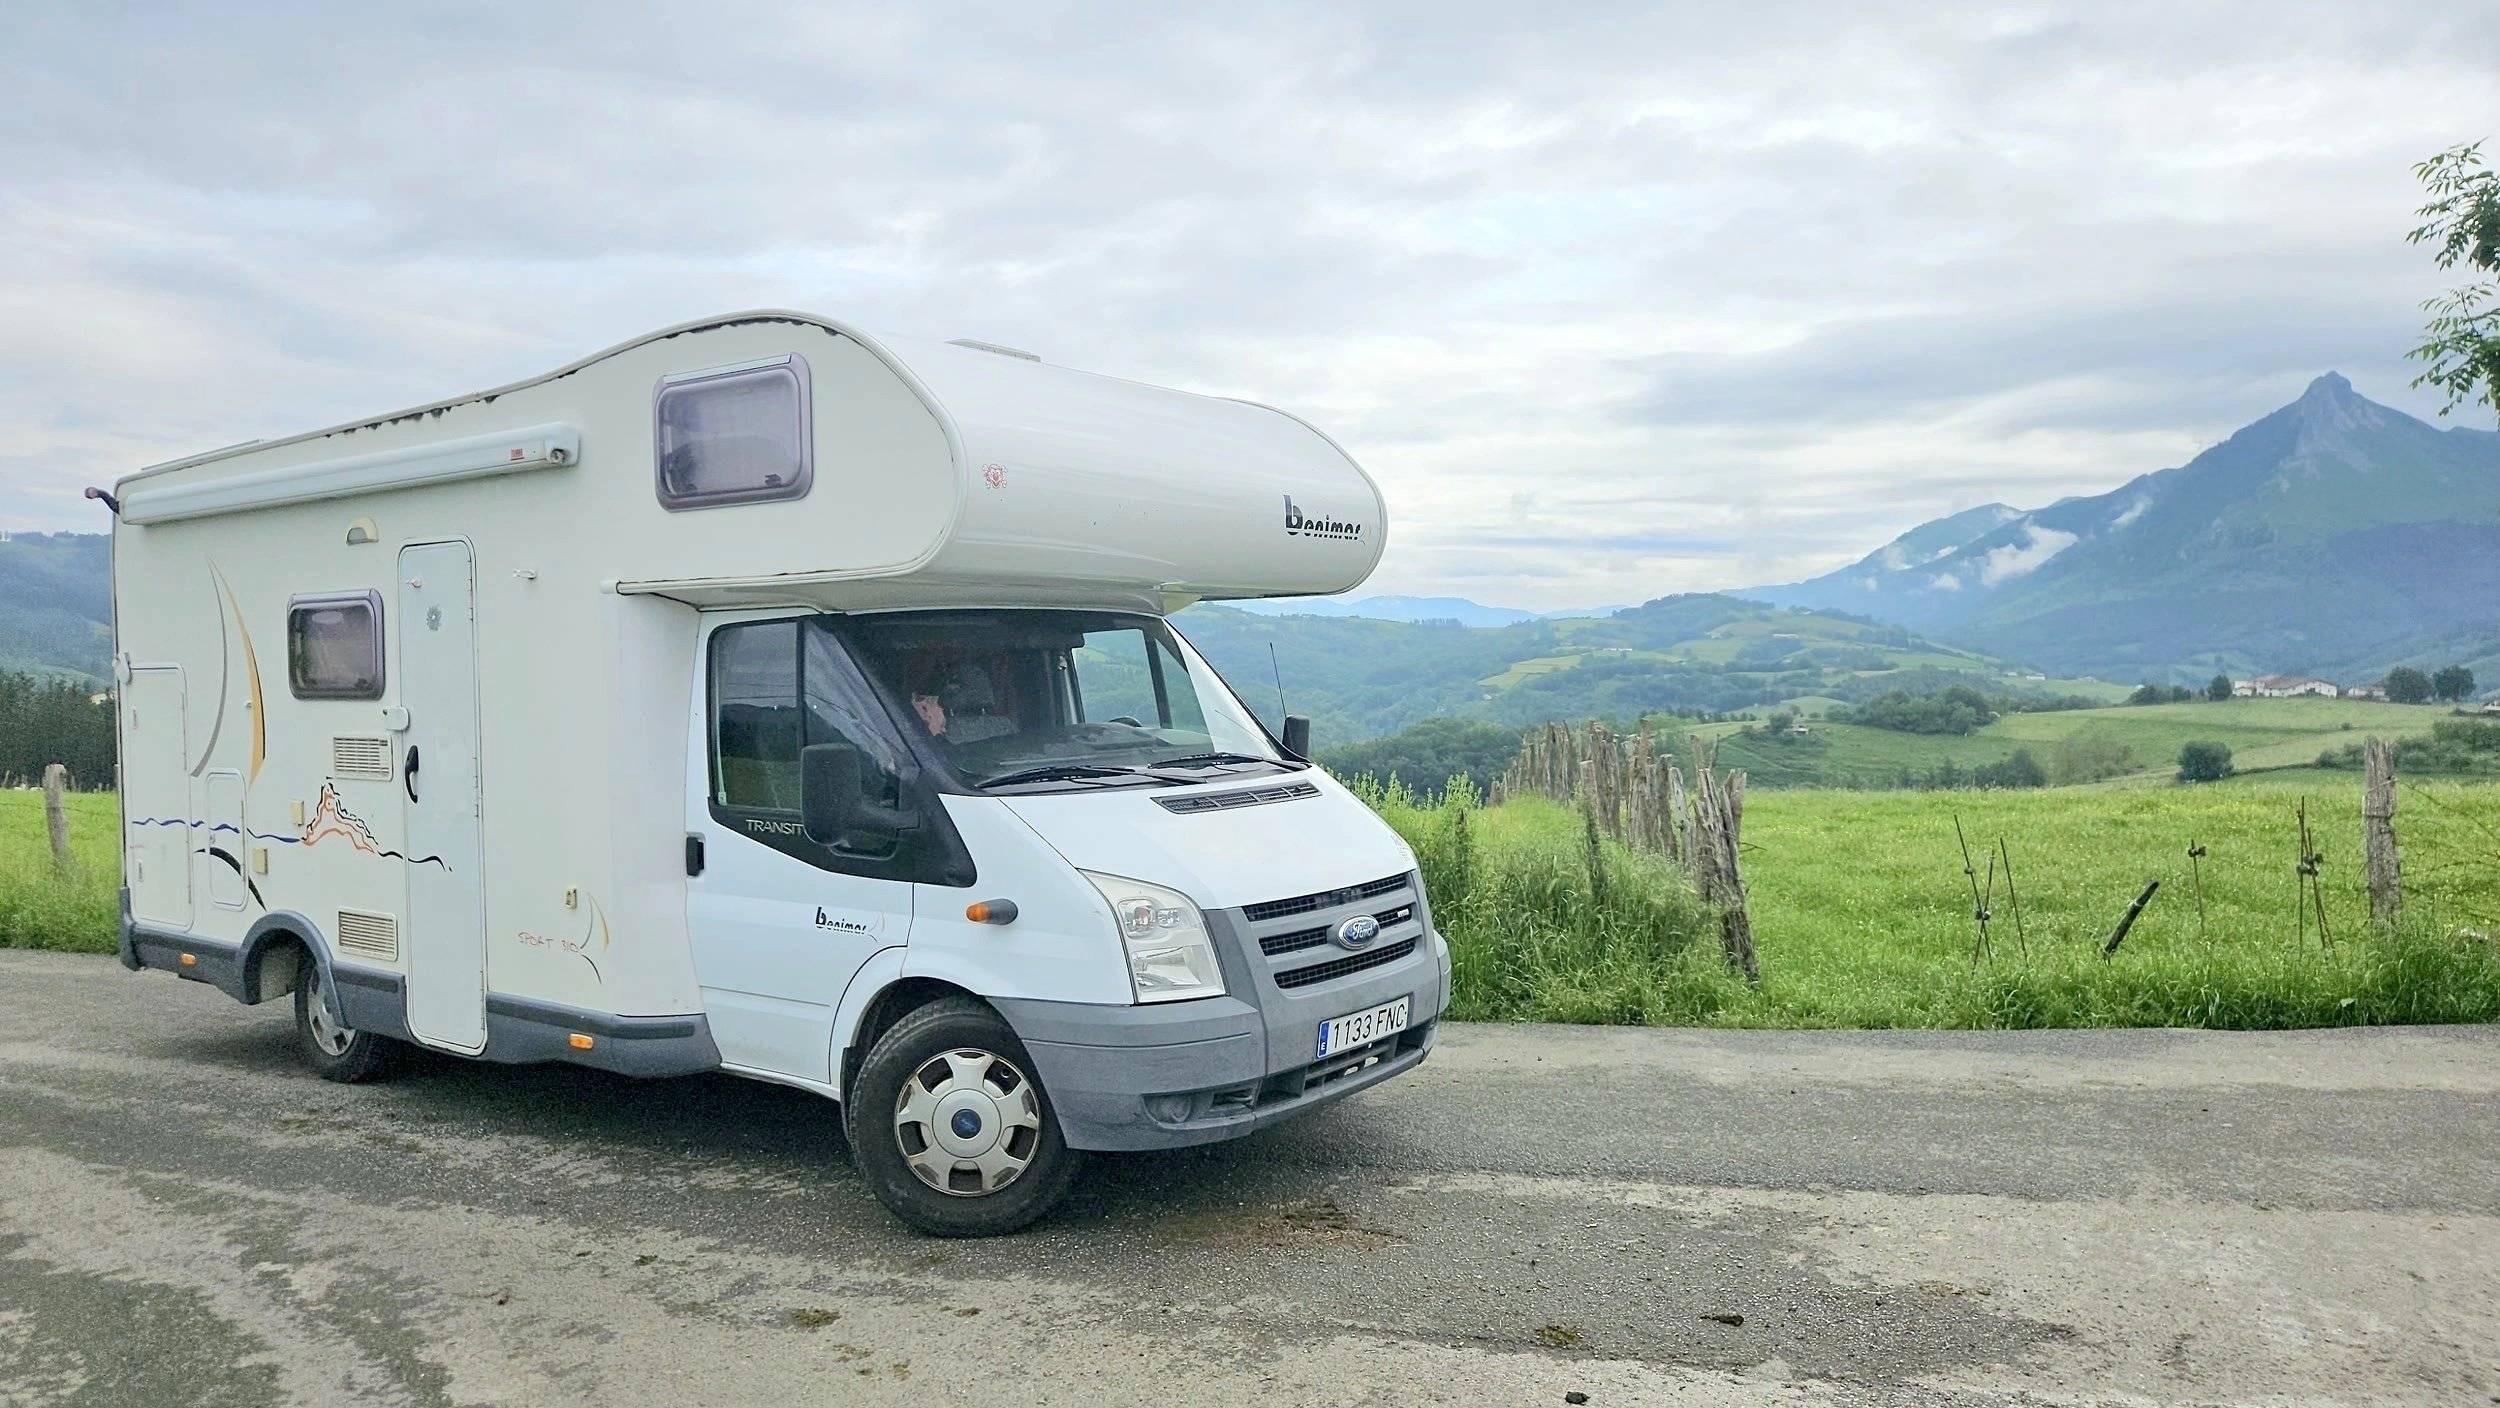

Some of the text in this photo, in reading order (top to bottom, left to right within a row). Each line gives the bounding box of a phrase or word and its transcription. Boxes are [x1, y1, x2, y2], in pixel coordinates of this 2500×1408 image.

[745, 819, 804, 836] TRANSIT
[1352, 921, 1374, 940] Ford
[1333, 1003, 1405, 1049] 1133 FNC
